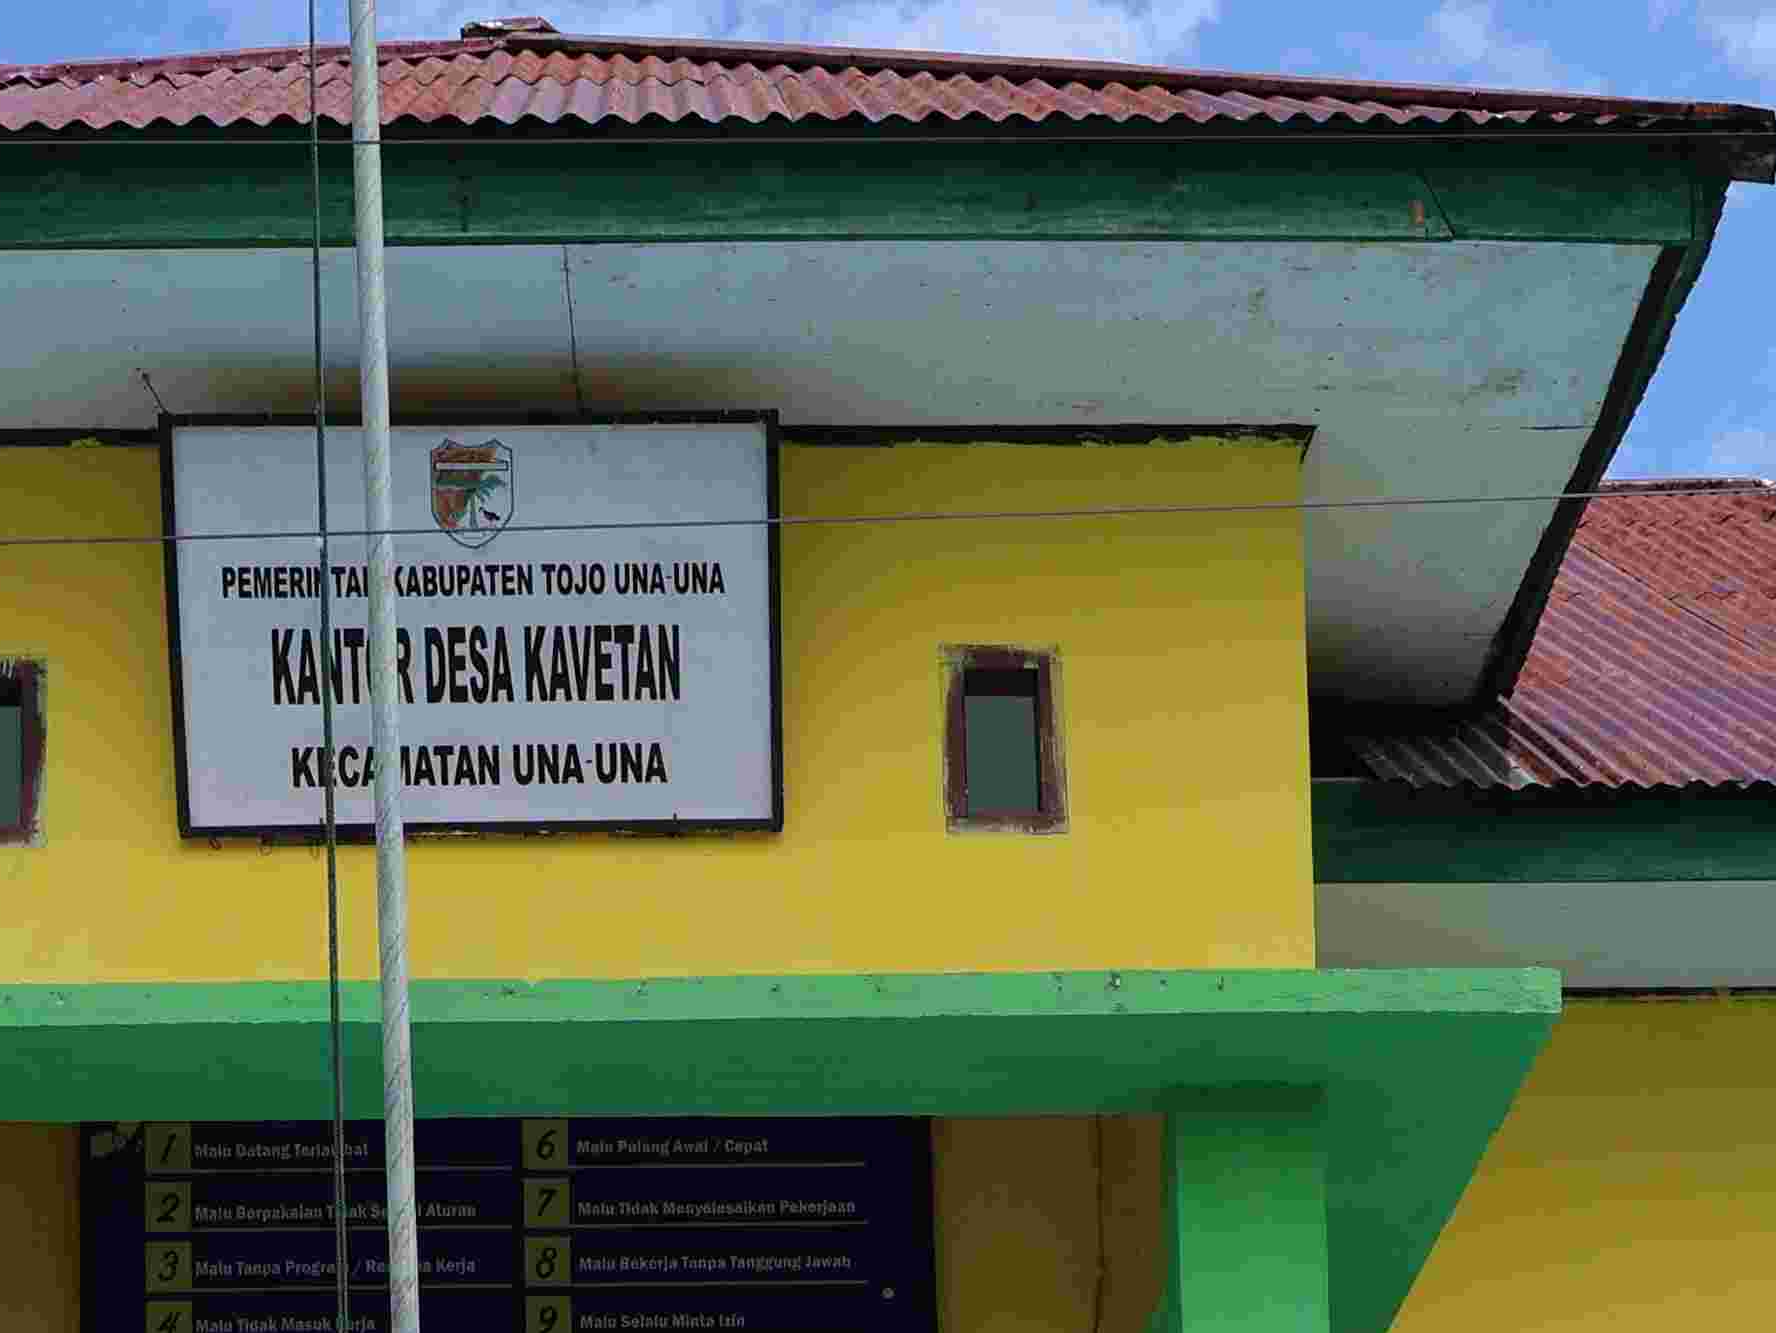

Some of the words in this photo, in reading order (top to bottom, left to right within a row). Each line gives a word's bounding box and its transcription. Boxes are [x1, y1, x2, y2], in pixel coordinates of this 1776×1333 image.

[222, 566, 372, 599] PEMERITA
[392, 564, 534, 598] KABUPATEN
[542, 563, 607, 596] TOJO
[613, 562, 725, 594] UNA-UNA
[271, 627, 416, 705] KANTR
[424, 625, 515, 704] DESA
[524, 624, 681, 702] KAVETAN
[512, 742, 668, 786] UNA-UNA
[194, 1143, 232, 1158] Malu
[236, 1143, 291, 1160] Datang
[294, 1143, 368, 1158] Terlabat
[536, 1130, 557, 1160] 6
[576, 1138, 614, 1154] Malu
[617, 1138, 670, 1159] Pulang
[673, 1138, 709, 1153] Awal
[156, 1193, 180, 1223] 2
[194, 1205, 232, 1219] Malu
[537, 1187, 559, 1217] 7
[578, 1201, 615, 1217] Malu
[618, 1201, 660, 1216] Tidak
[780, 1199, 856, 1217] Pekerjaan
[157, 1250, 179, 1282] 3
[195, 1261, 232, 1276] Malu
[236, 1260, 281, 1278] Tanpa
[435, 1257, 476, 1277] Kerja
[536, 1247, 558, 1279] 8
[578, 1256, 617, 1271] Malu
[619, 1256, 678, 1272] Bekerja
[680, 1255, 725, 1272] Tanpa
[728, 1255, 801, 1272] Tanggung
[805, 1254, 852, 1270] Jawab
[196, 1319, 233, 1333] Malu
[236, 1317, 277, 1333] Tidak
[280, 1318, 331, 1333] Masuk
[580, 1313, 617, 1329] Malu
[620, 1313, 668, 1328] Selalu
[671, 1312, 715, 1328] Minta
